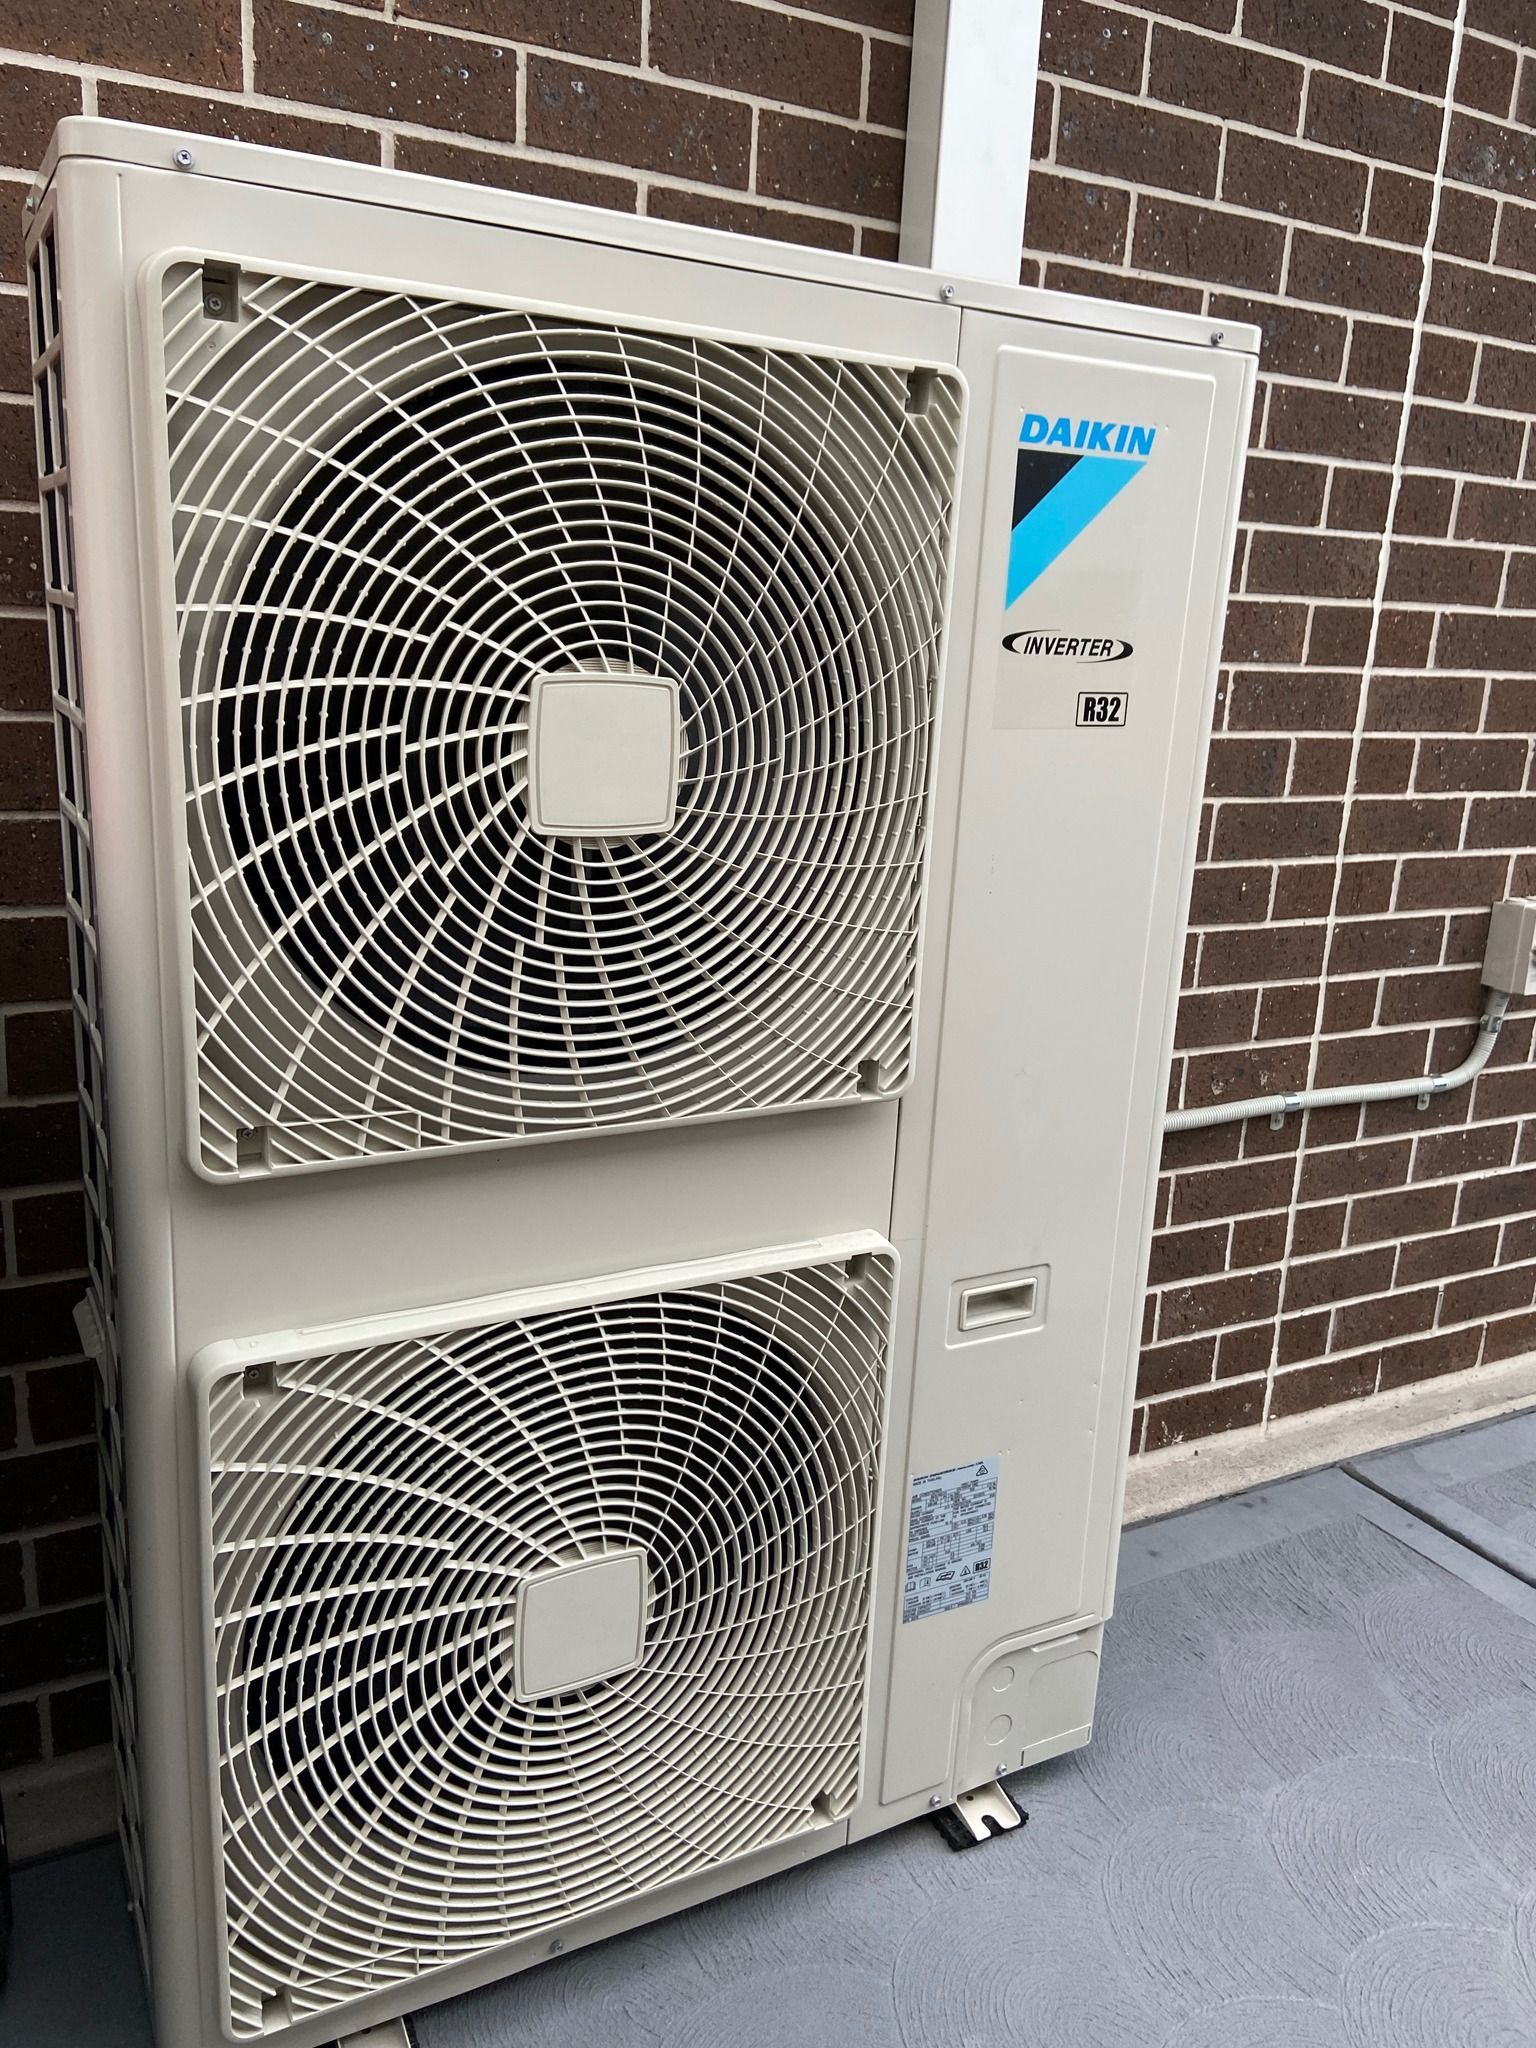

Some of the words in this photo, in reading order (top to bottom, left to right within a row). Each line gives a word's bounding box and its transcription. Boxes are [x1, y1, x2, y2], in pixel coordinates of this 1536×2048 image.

[1018, 412, 1156, 456] DAIKIN
[1023, 636, 1114, 657] INVERTER
[1082, 696, 1121, 722] R32
